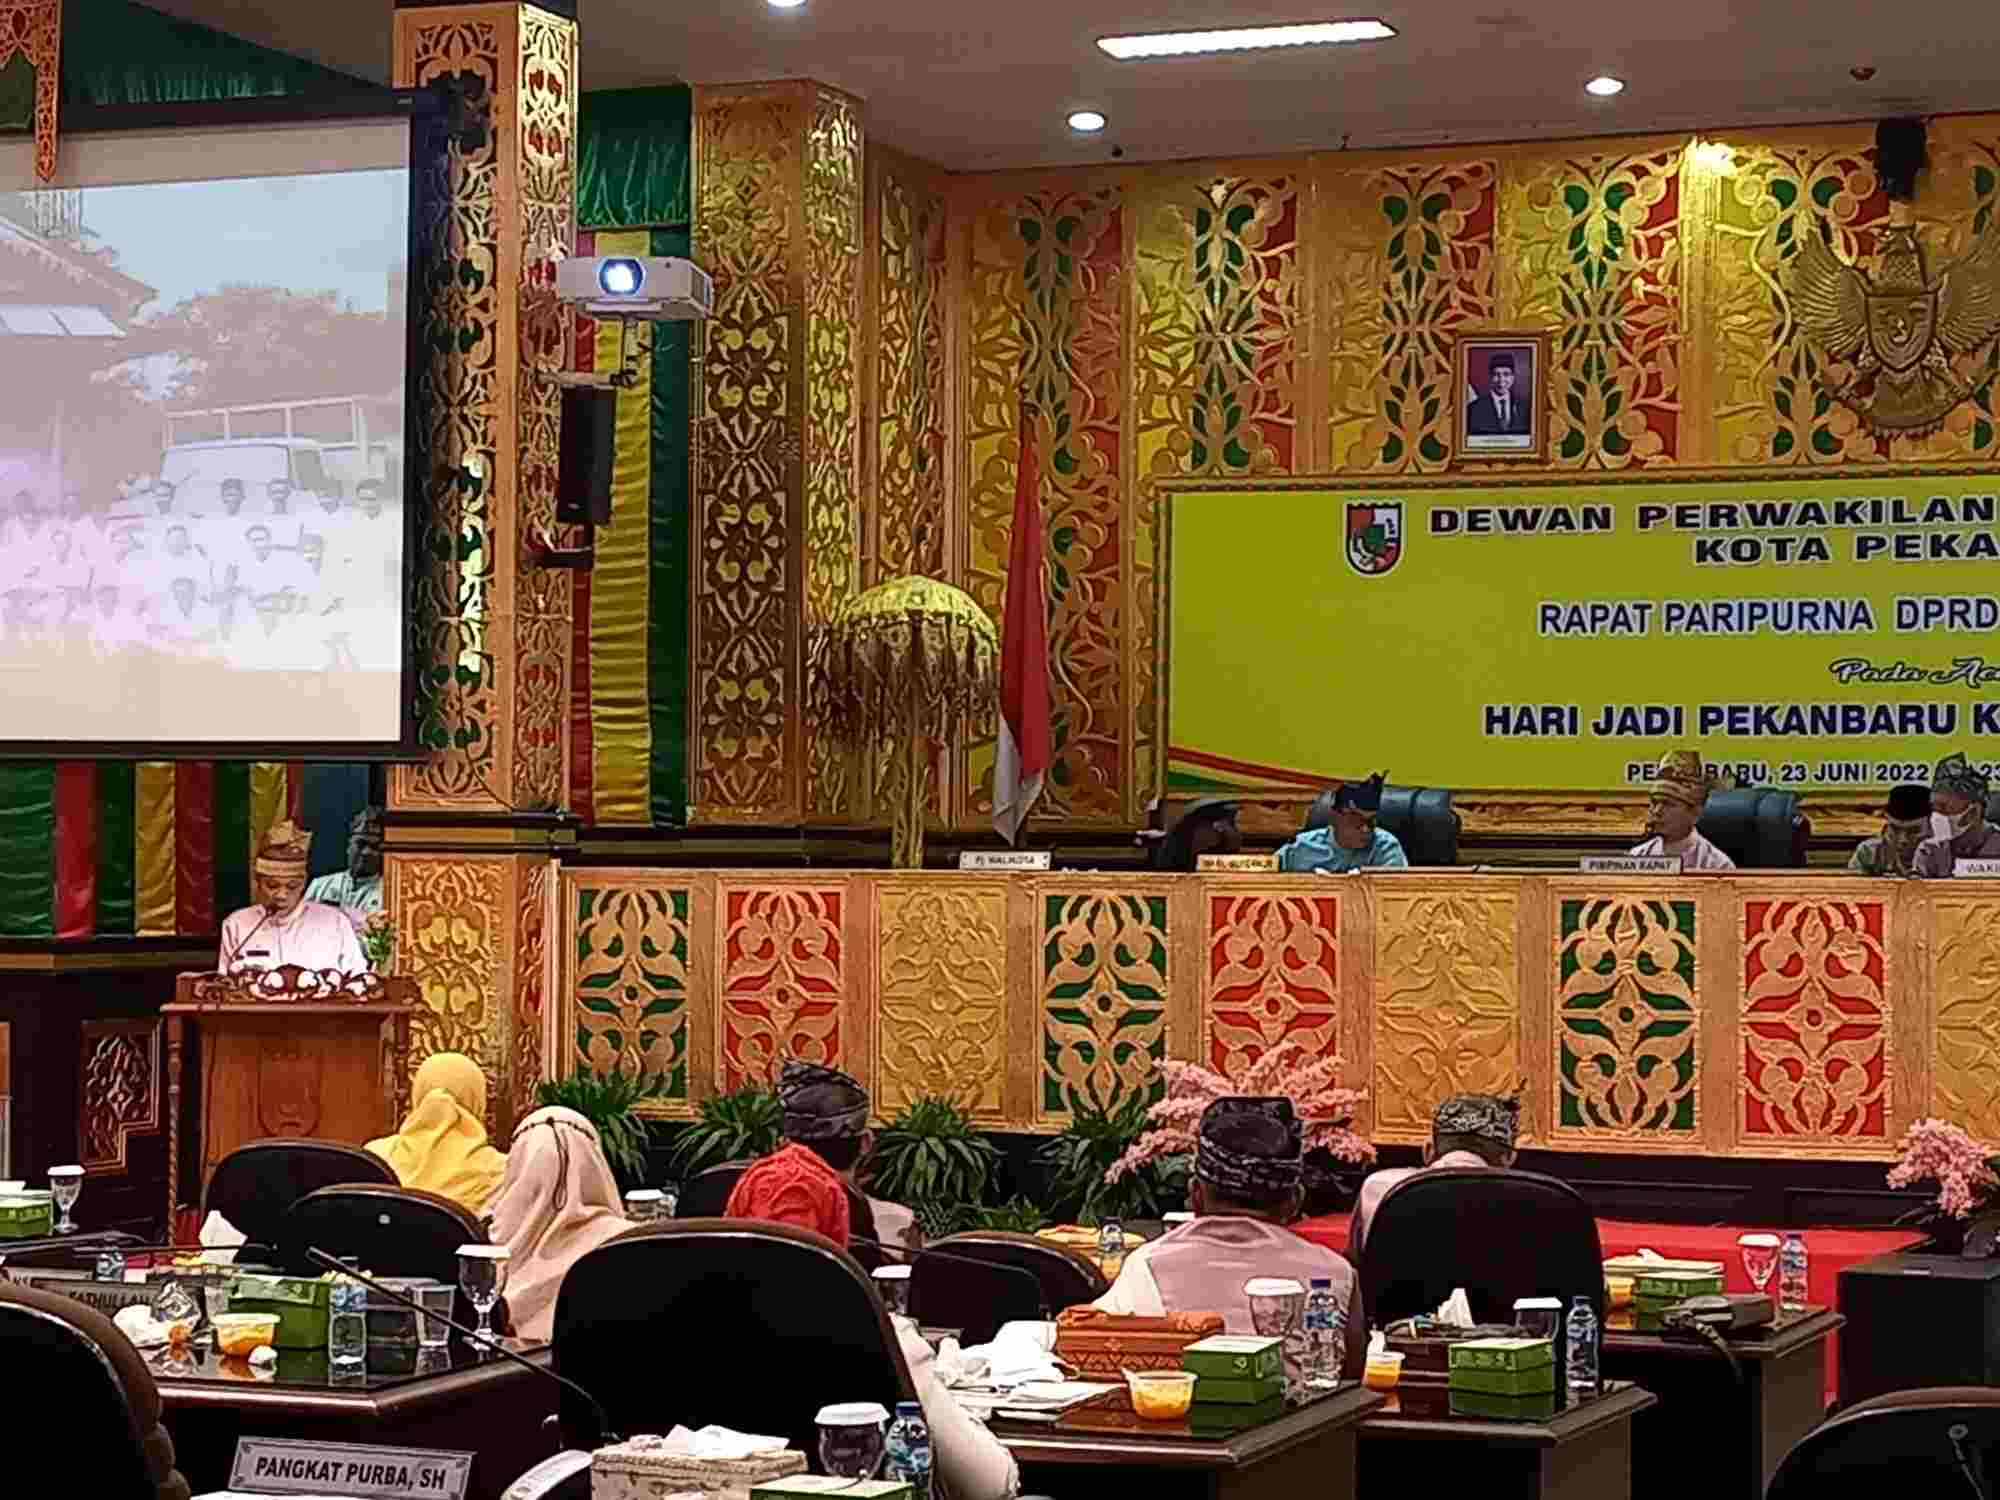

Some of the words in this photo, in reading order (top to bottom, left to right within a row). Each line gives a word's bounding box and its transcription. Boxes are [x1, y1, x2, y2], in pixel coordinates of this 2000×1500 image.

[1430, 506, 1612, 533] DEWAN
[1638, 497, 1994, 530] PERWAKILAN
[1695, 535, 1830, 563] KOTA
[1539, 602, 1653, 634] RAPAT
[1665, 600, 1873, 633] PARIPURNA
[1897, 598, 1998, 630] DPRD
[1829, 657, 1927, 684] Pada
[1485, 705, 1579, 736] HARI
[1592, 705, 1683, 736] JADI
[1700, 703, 1957, 736] PEKANBARU
[1781, 763, 1806, 782] 23
[1813, 763, 1867, 782] JUNI
[1875, 762, 1929, 782] 2022
[254, 1456, 342, 1482] PANGKAT
[346, 1461, 414, 1491] PURBA,
[419, 1467, 447, 1490] SH
